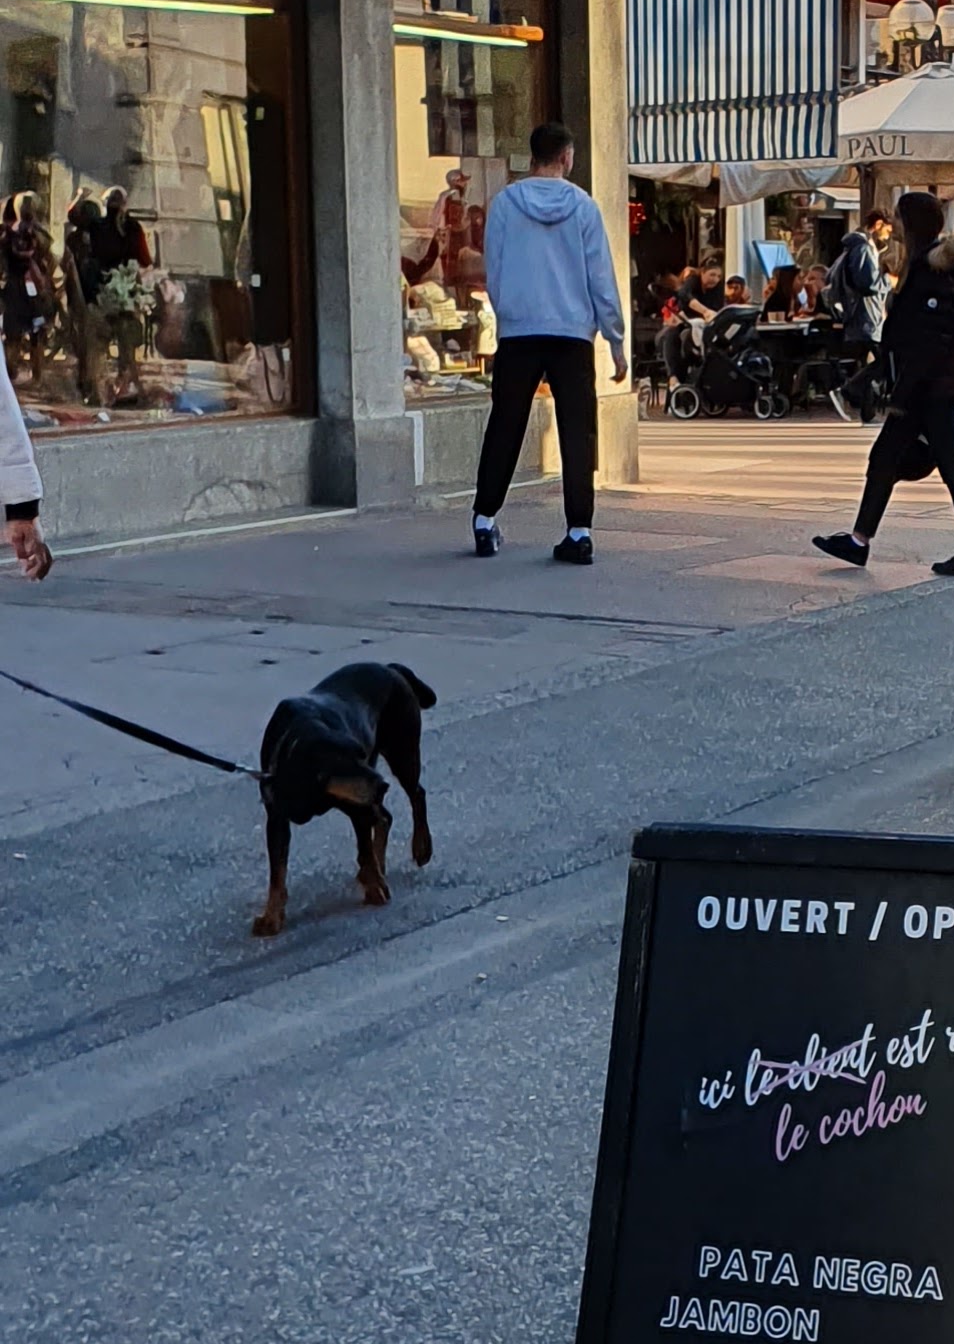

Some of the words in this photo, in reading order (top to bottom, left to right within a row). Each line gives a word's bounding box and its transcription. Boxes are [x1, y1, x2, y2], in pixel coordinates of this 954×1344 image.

[847, 135, 915, 159] PAUL
[697, 895, 855, 935] OUVERT
[868, 901, 888, 941] /
[699, 1070, 736, 1109] ici
[744, 1048, 780, 1106] le
[786, 1022, 877, 1092] client
[886, 1008, 936, 1069] est
[775, 1103, 809, 1162] le
[818, 1070, 928, 1144] cochon
[699, 1246, 800, 1288] PATA
[813, 1256, 944, 1301] NEGRA
[660, 1296, 820, 1342] JAMBON
